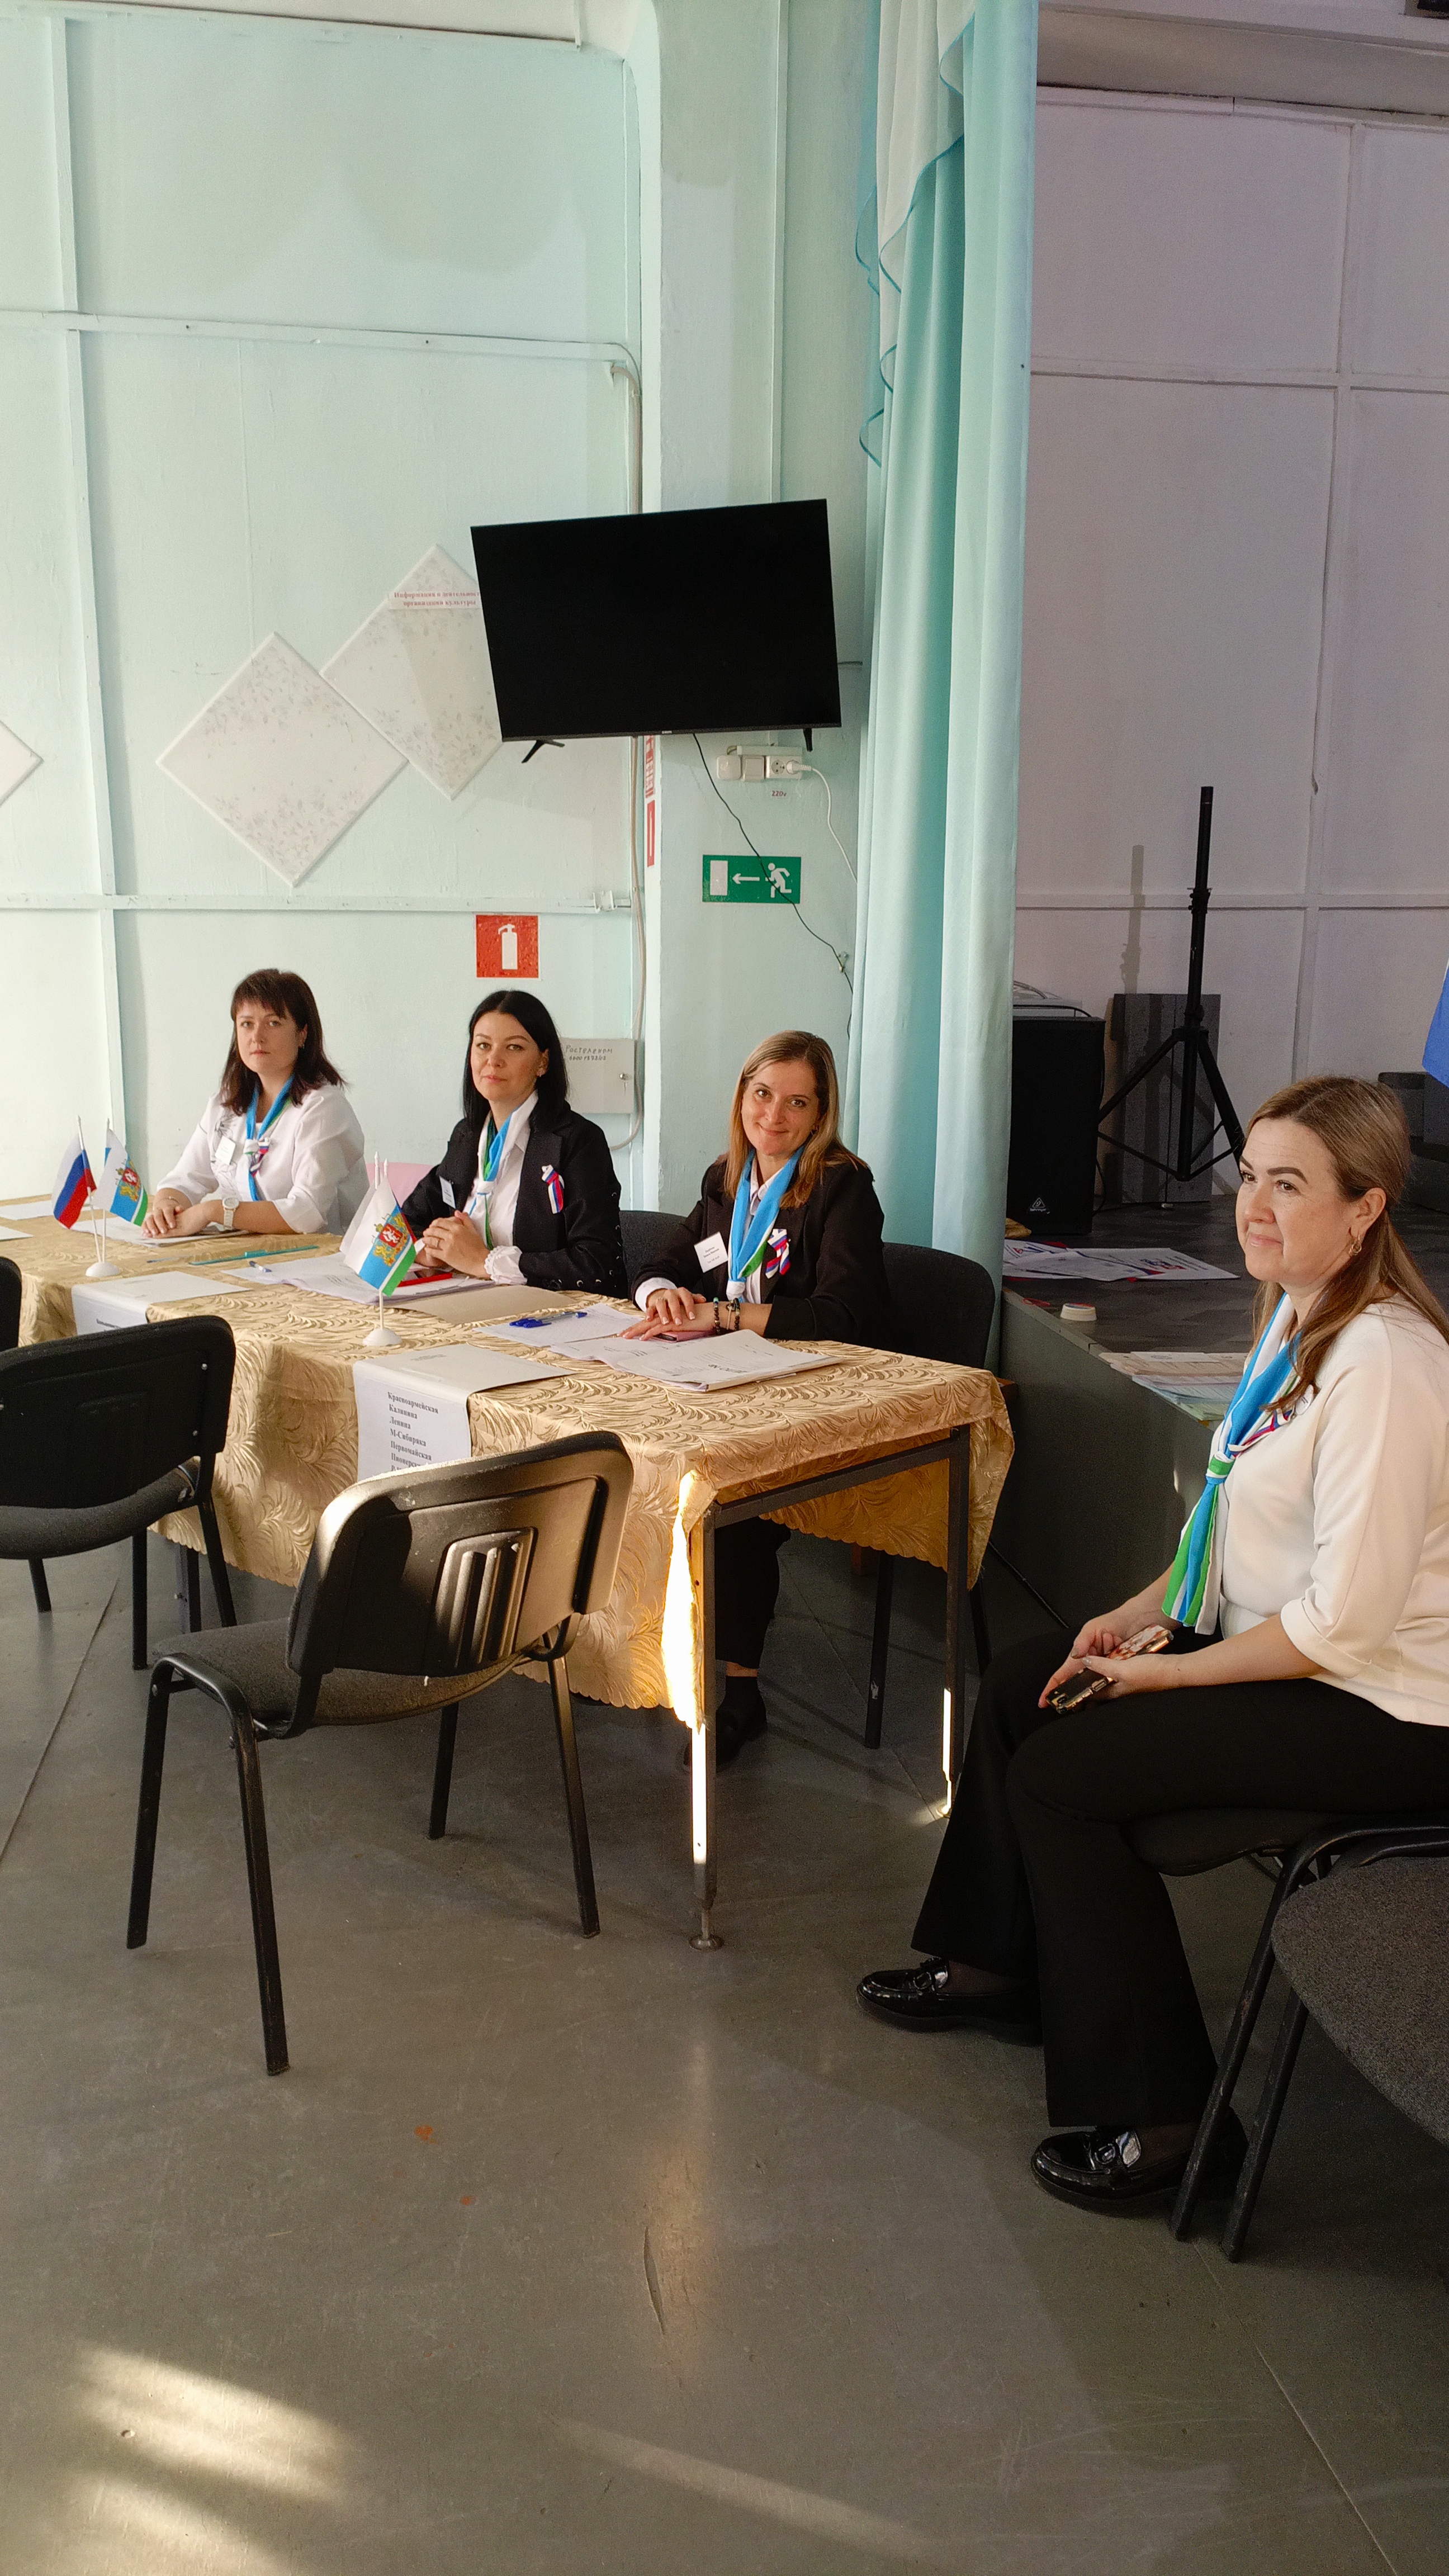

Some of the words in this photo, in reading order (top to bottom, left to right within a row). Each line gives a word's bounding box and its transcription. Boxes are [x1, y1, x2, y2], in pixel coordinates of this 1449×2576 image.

[565, 1045, 613, 1054] Ростелеком
[387, 1391, 439, 1414] Красноармейская
[389, 1404, 418, 1419] Калинина
[389, 1416, 411, 1429] Ленина
[390, 1428, 427, 1447] М-Сибиряка
[390, 1440, 432, 1461] Первомайская
[391, 1452, 421, 1468] Пионерск
